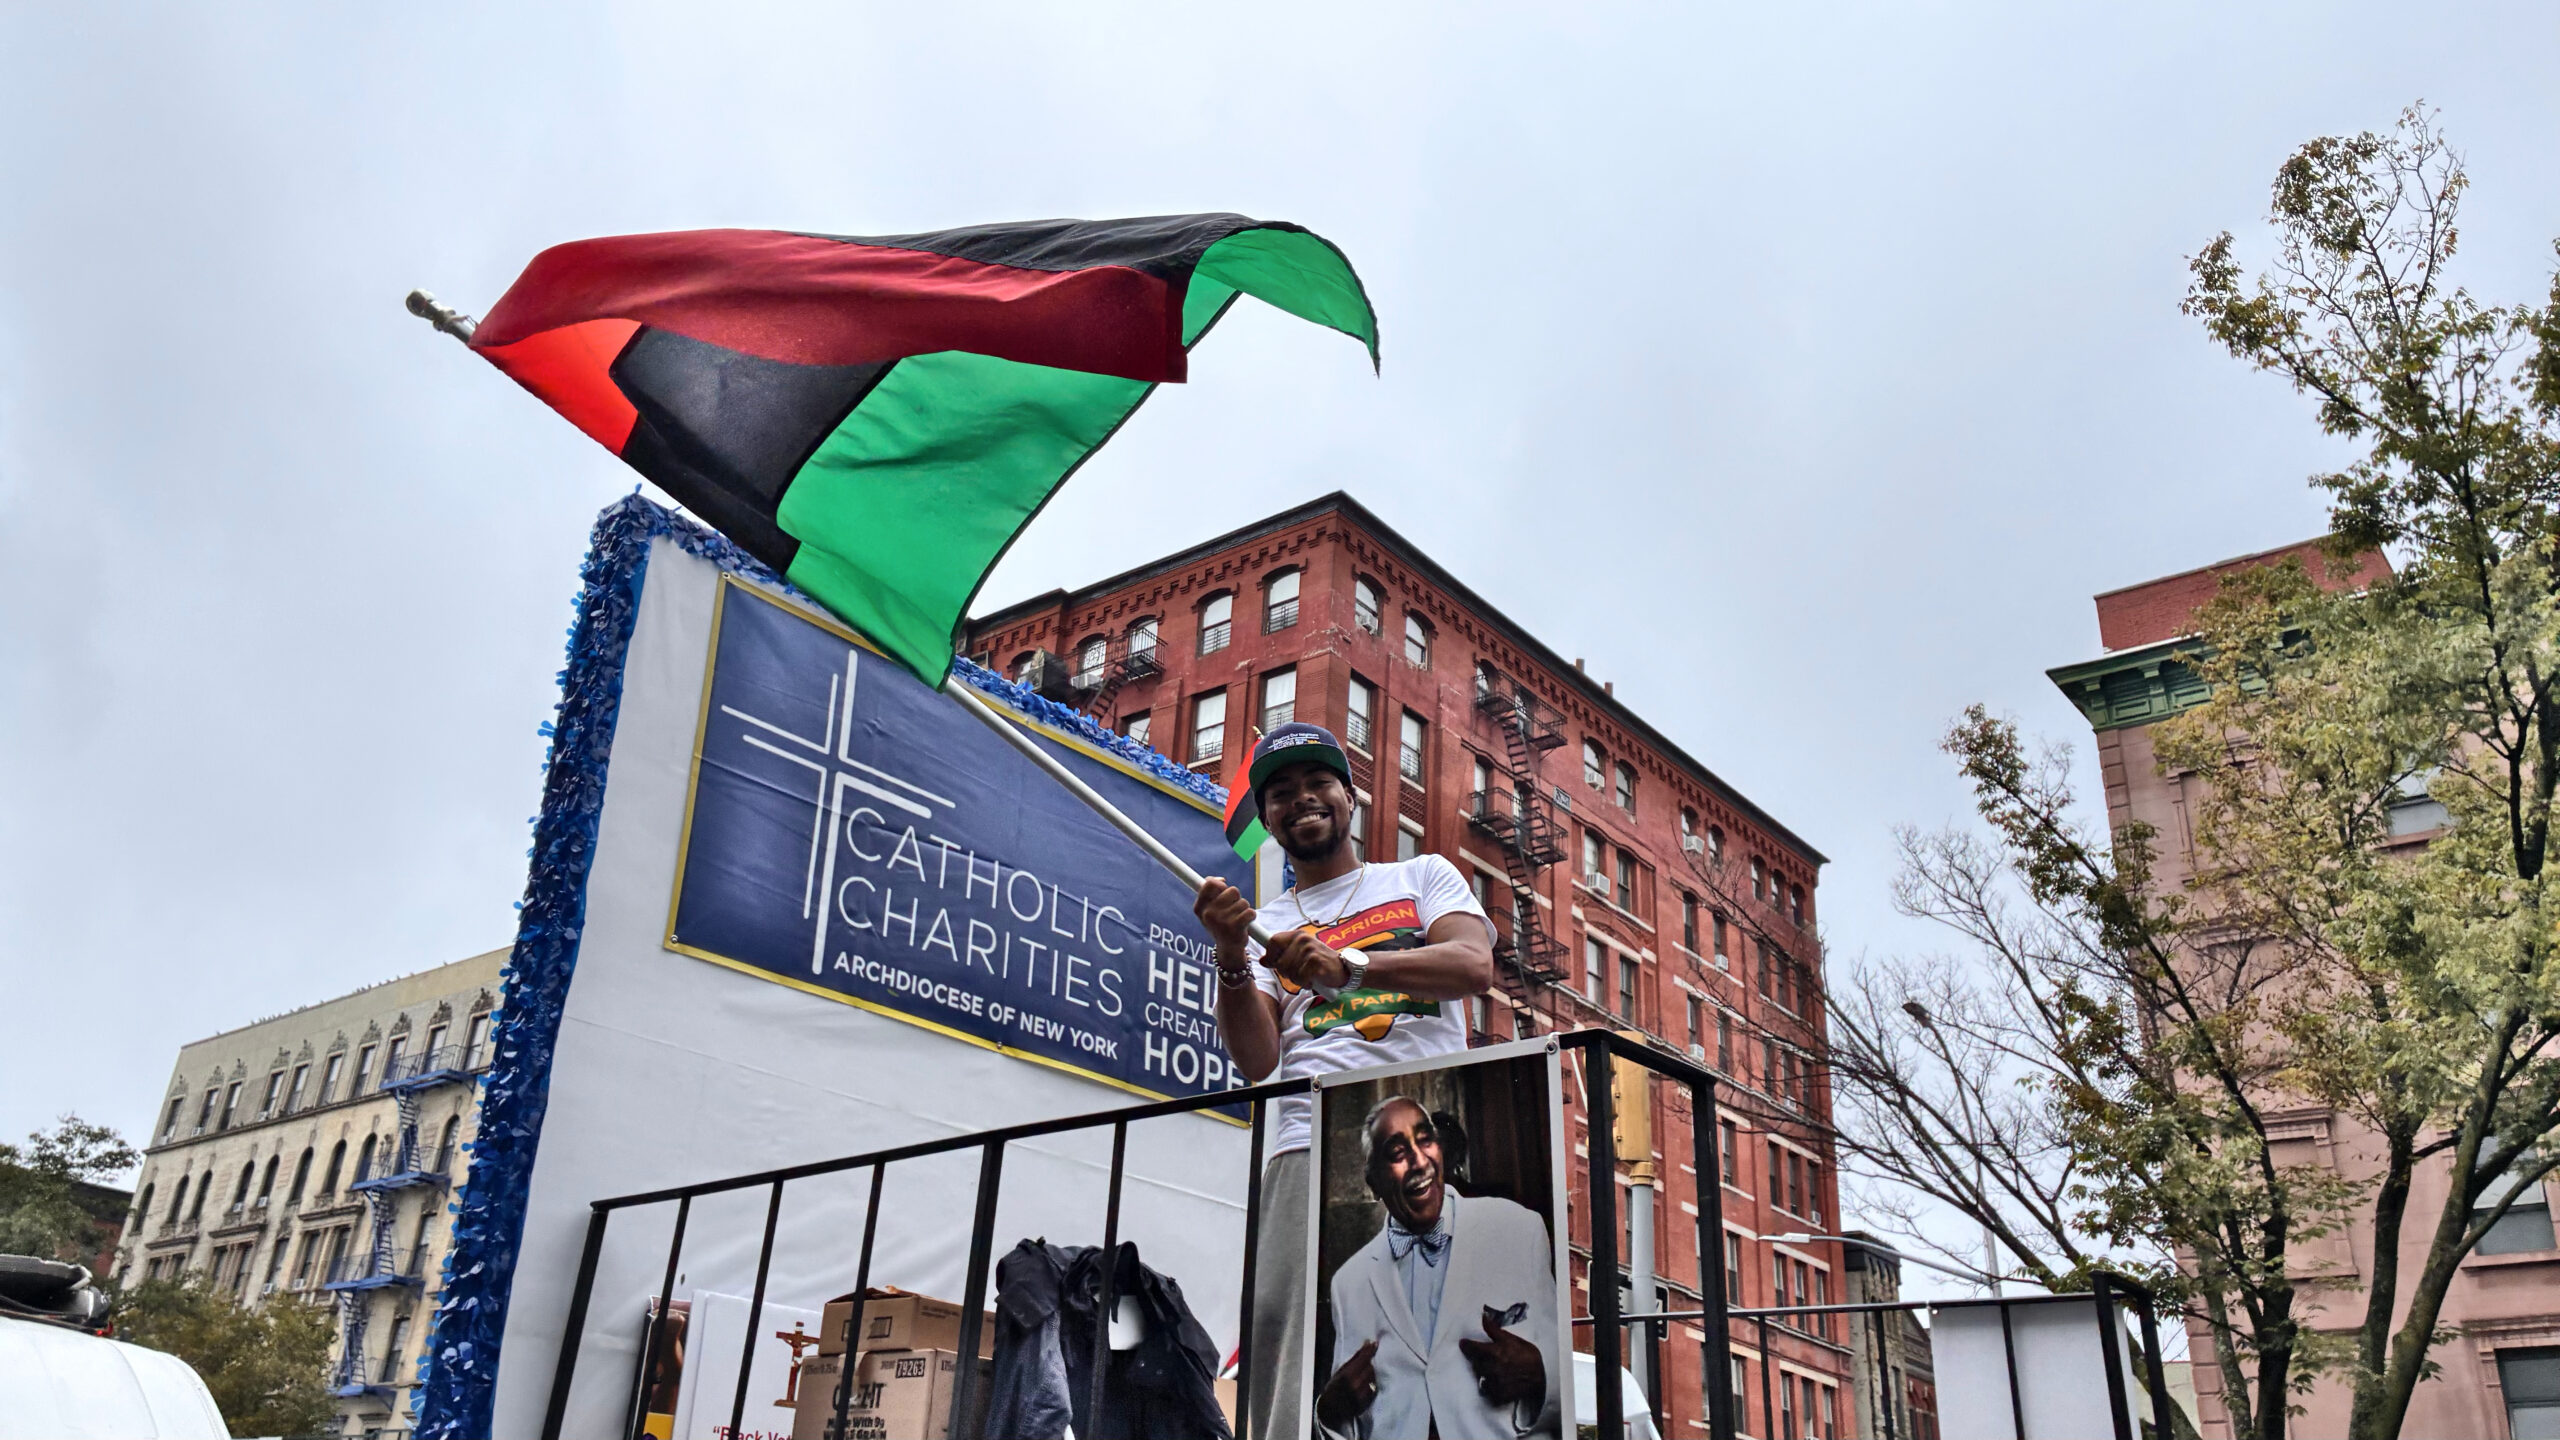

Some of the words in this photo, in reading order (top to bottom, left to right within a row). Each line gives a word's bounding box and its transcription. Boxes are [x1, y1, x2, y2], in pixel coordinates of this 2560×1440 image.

[846, 807, 1126, 954] CATHOLIC
[838, 876, 1123, 1017] CHARITIES
[1149, 923, 1214, 967] PROVID
[1324, 907, 1416, 944] AFRICAN
[833, 951, 984, 1016] ARCHDIOCESE
[988, 1002, 1016, 1026] OF
[1019, 1014, 1065, 1042] NEW
[1069, 1027, 1118, 1060] YORK
[1148, 950, 1214, 1016] HEL
[1145, 1002, 1222, 1050] CREATI
[1309, 1003, 1345, 1029] DAY
[1350, 993, 1434, 1011] PARA
[897, 1360, 925, 1377] 79263
